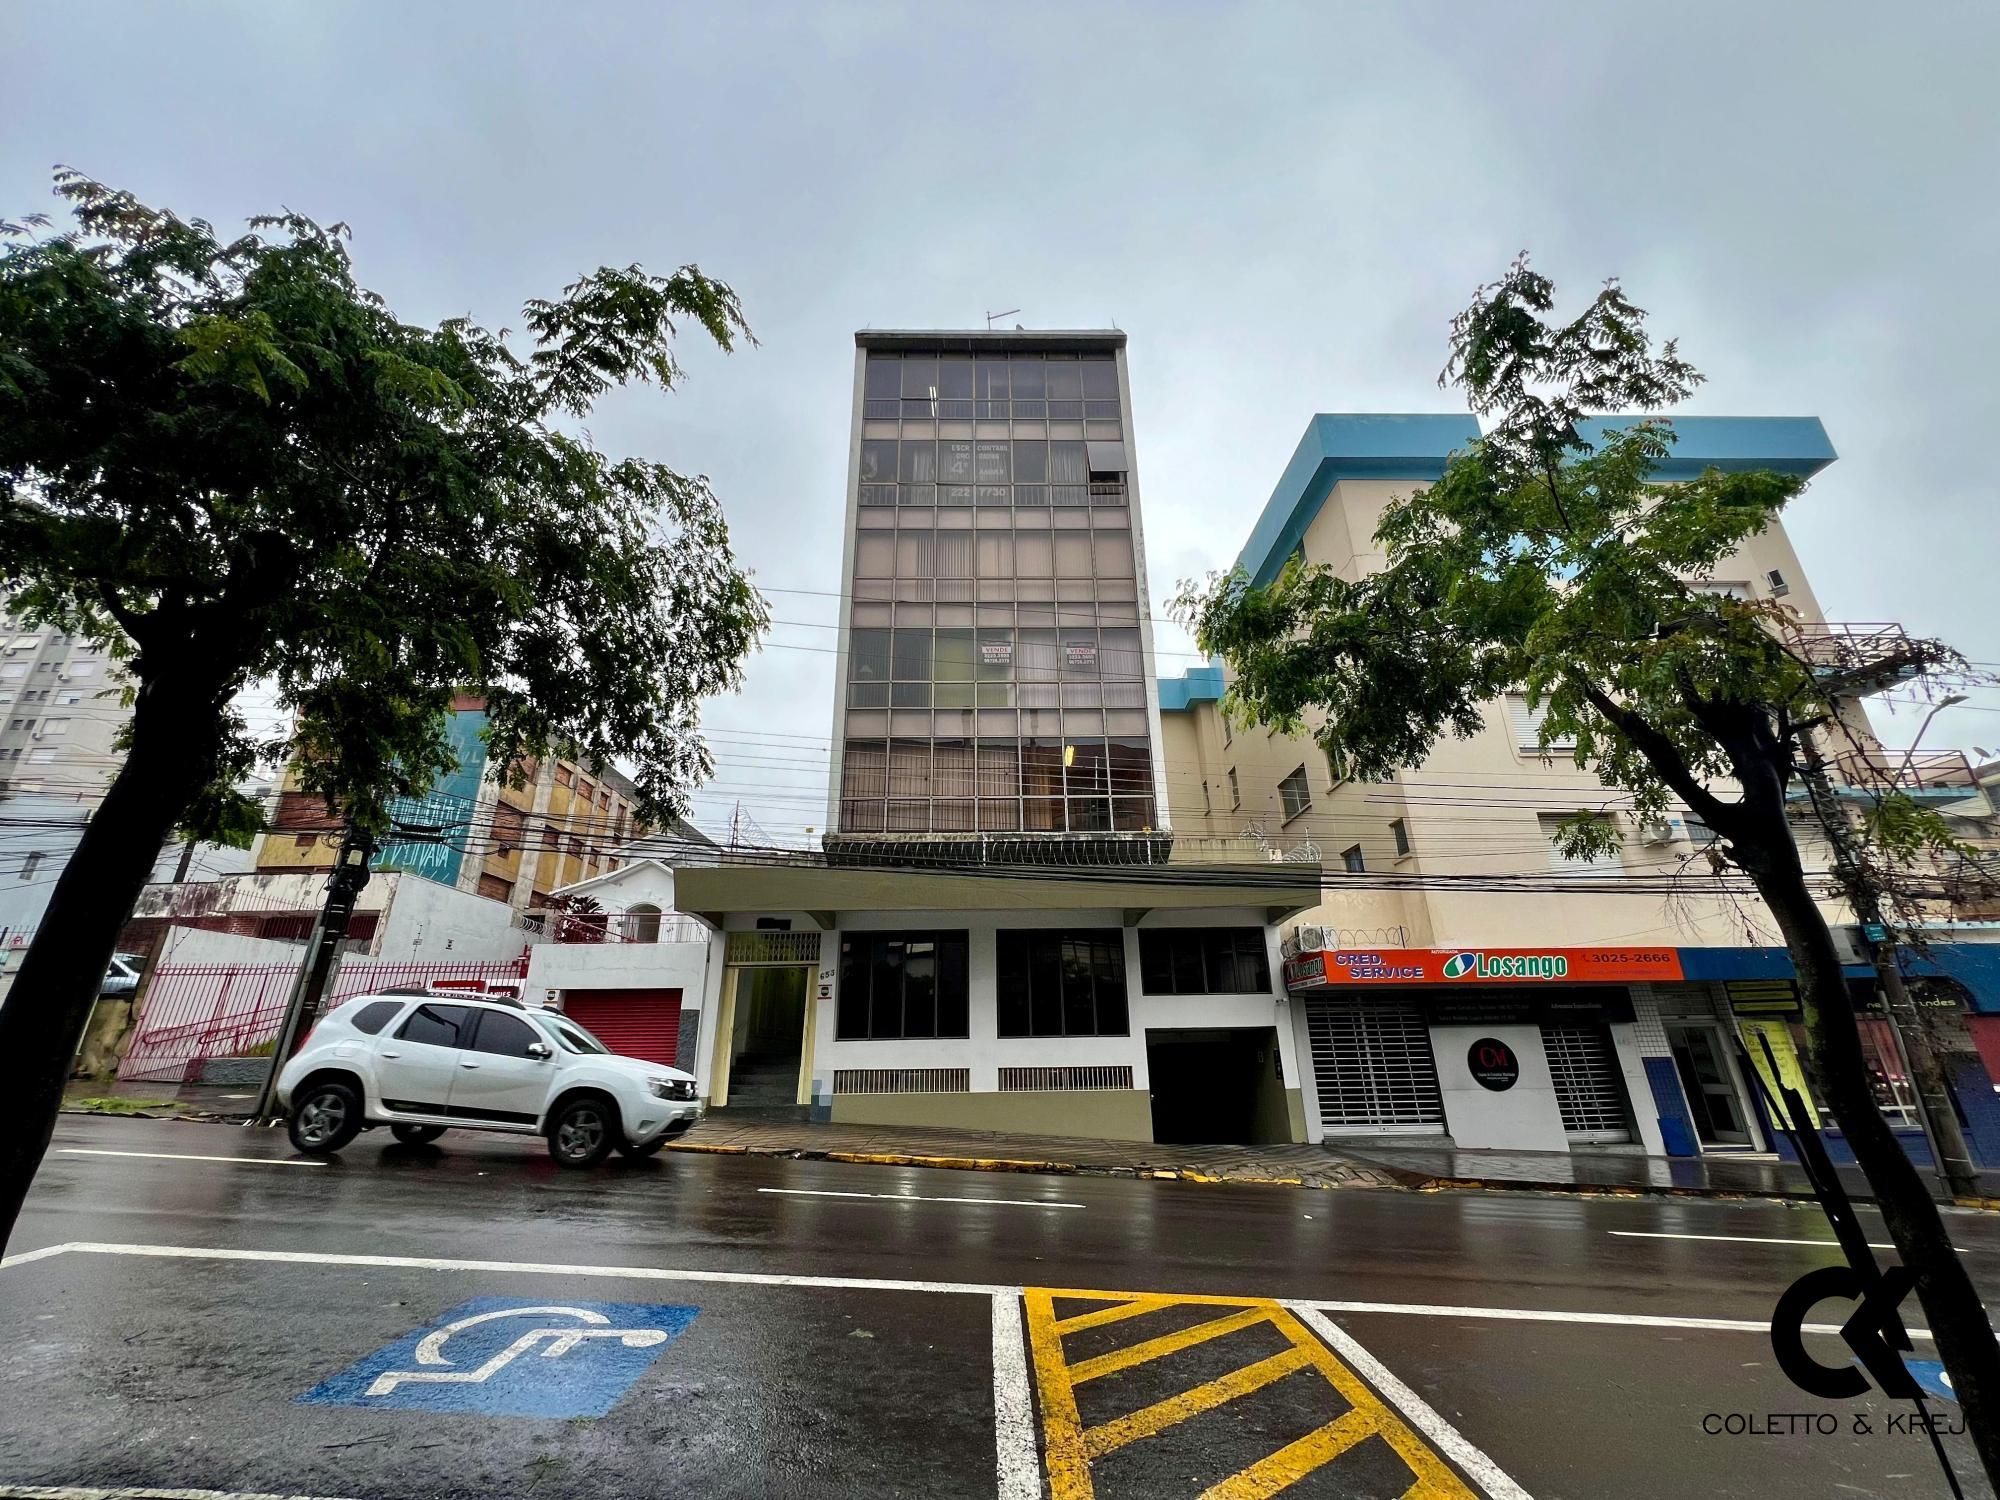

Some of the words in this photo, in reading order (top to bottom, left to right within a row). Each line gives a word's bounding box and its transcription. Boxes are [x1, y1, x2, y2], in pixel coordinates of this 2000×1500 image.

[1336, 954, 1387, 966] CRED.
[1591, 953, 1671, 963] 3025-2666
[1476, 952, 1568, 979] Losango
[820, 969, 835, 980] 653
[1350, 966, 1425, 979] SERVICE
